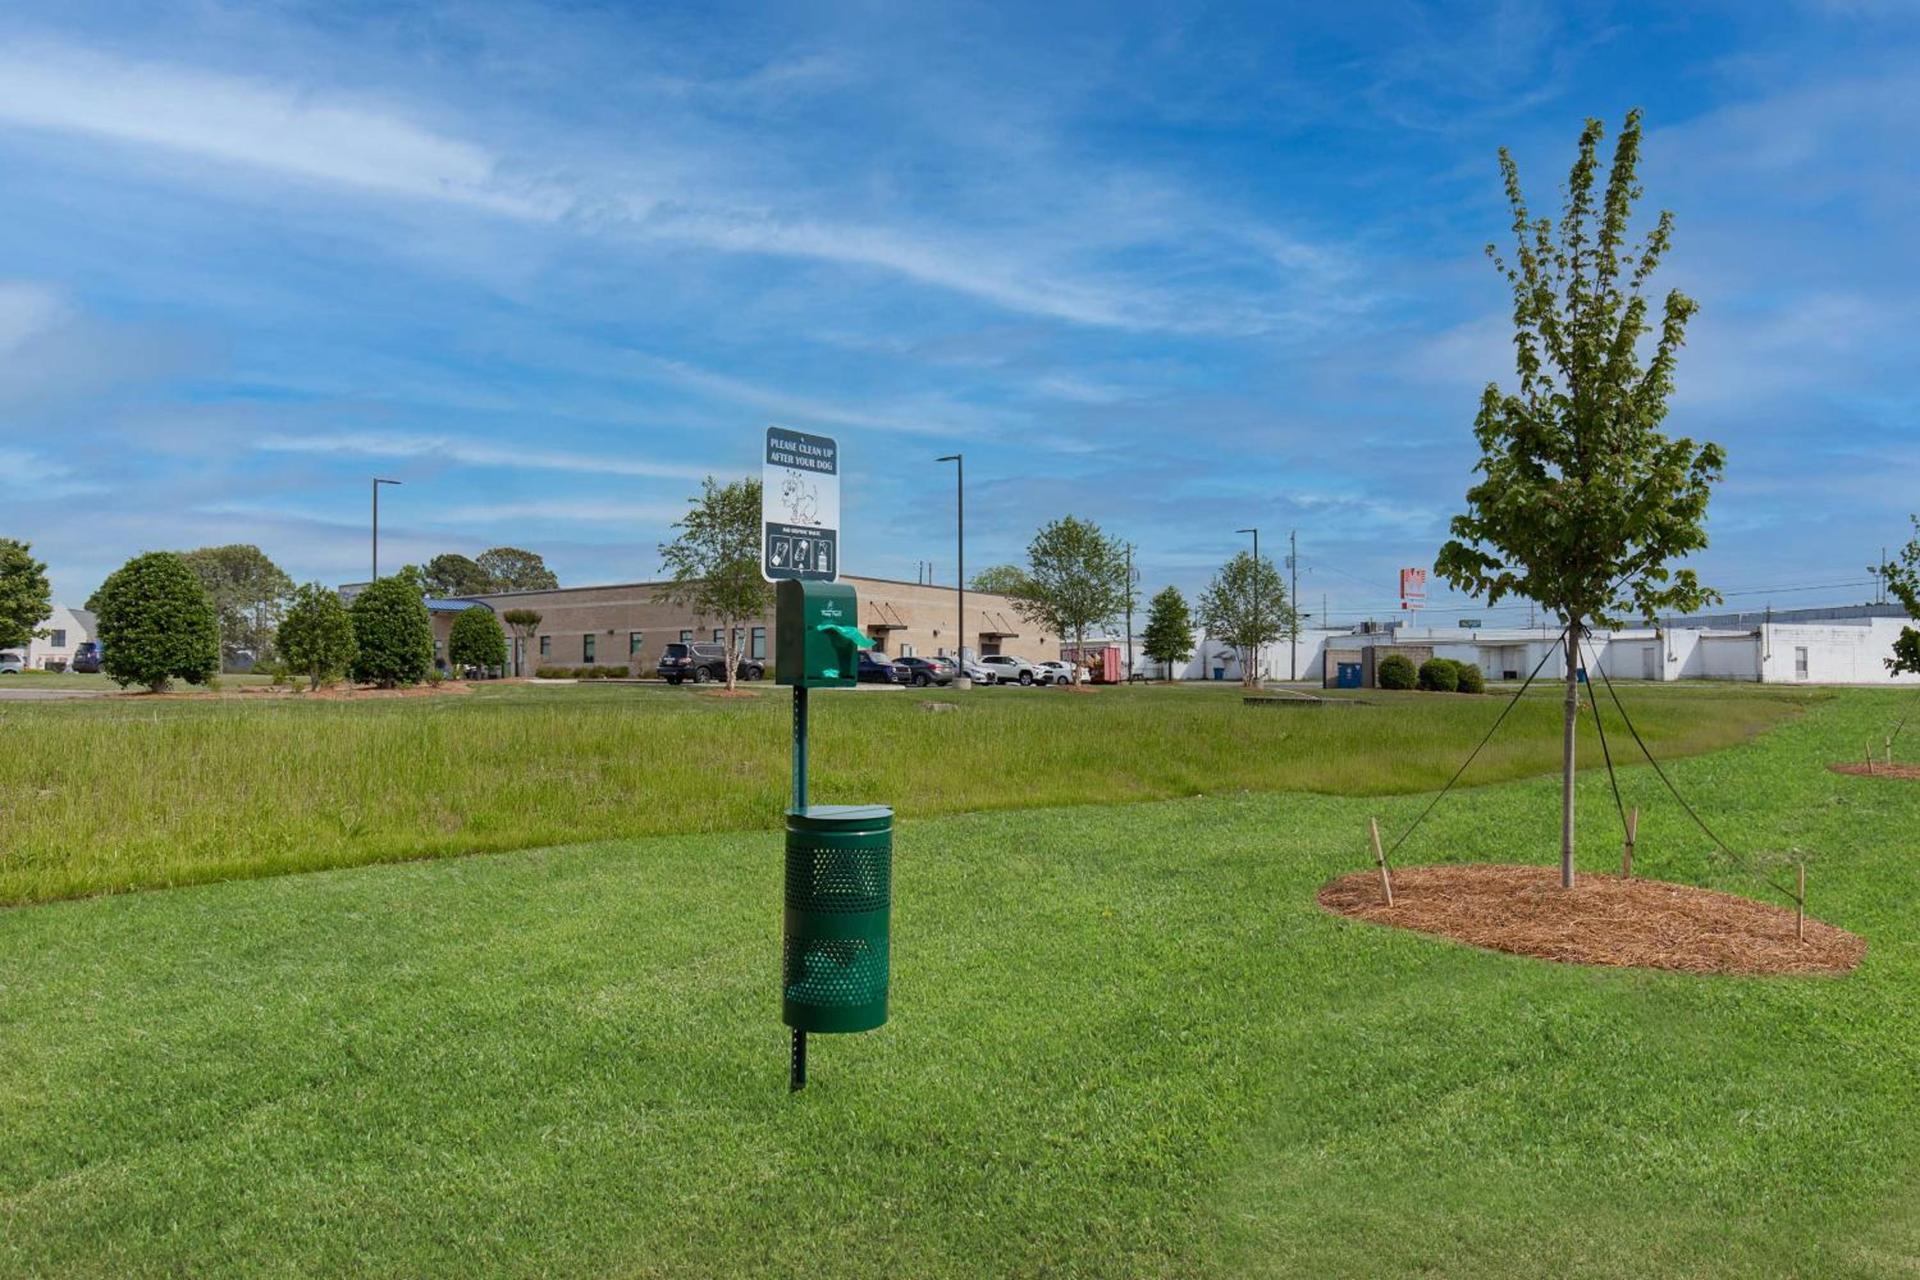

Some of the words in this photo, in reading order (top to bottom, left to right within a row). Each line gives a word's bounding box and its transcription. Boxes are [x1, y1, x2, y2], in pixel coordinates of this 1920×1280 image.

[771, 438, 796, 451] PLEASE
[799, 443, 821, 457] CLEAN
[823, 448, 833, 458] UP
[771, 451, 794, 464] AFTER
[795, 456, 815, 468] YOUR
[817, 460, 833, 470] DOG
